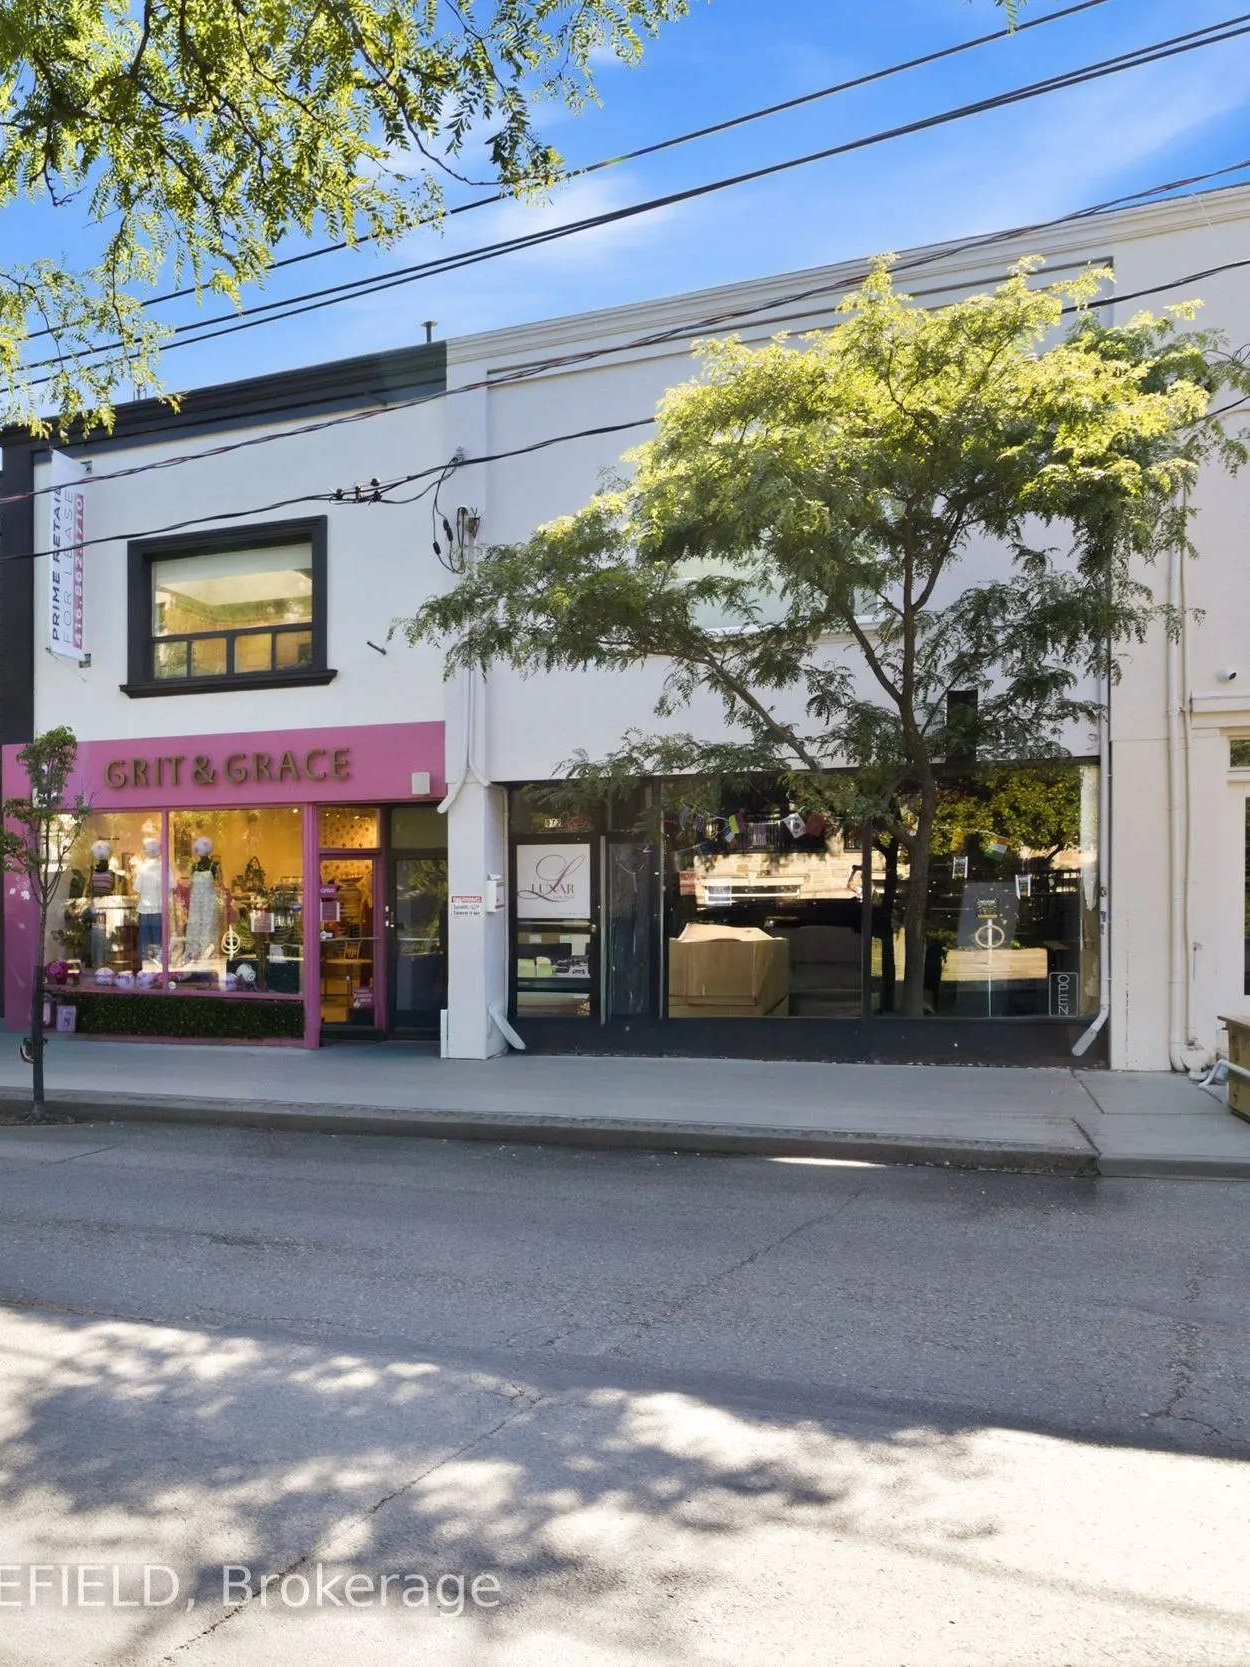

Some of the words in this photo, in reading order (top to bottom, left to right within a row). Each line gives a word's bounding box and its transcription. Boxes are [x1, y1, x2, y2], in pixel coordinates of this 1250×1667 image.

[63, 488, 73, 576] LEASE
[52, 570, 61, 641] PRIME
[63, 590, 72, 644] FOR
[1057, 974, 1070, 1015] OPEN
